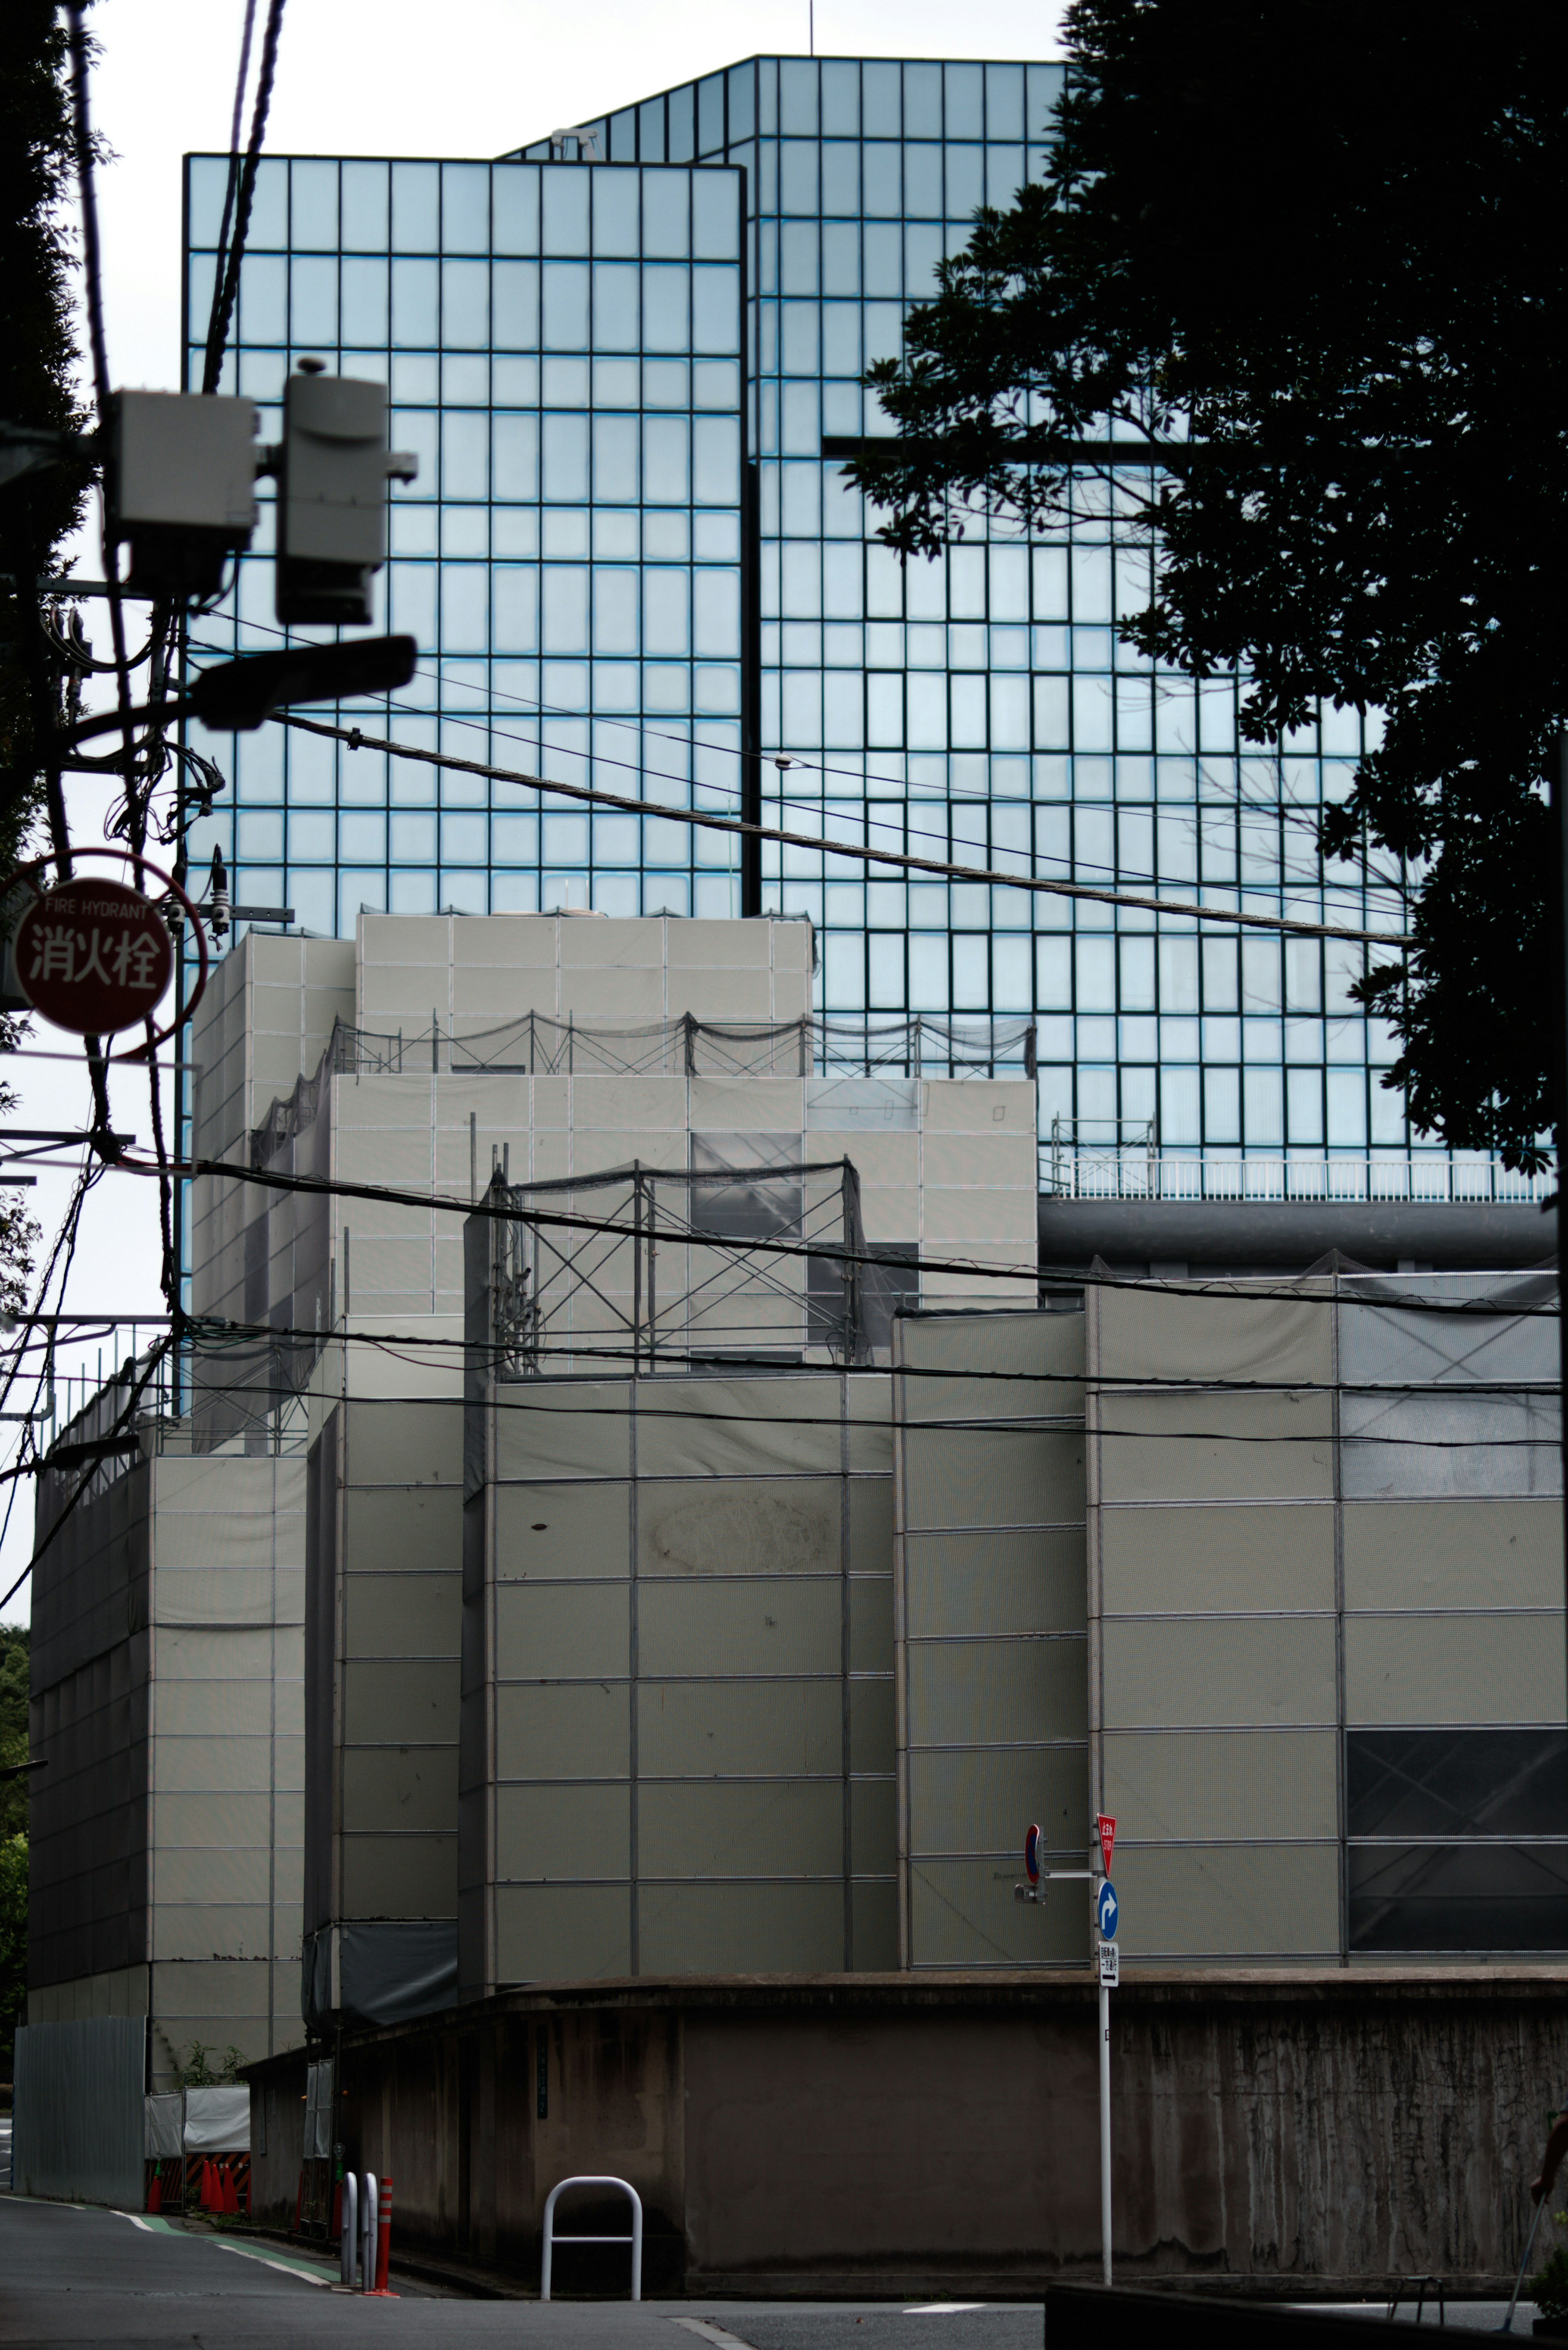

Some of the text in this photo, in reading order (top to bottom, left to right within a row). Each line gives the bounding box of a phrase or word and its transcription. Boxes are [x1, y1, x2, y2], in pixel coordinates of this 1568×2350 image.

[45, 897, 148, 920] FIRE HYDRANT
[30, 923, 160, 989] 消火栓
[1102, 1822, 1113, 1836] 止まれ
[1101, 1947, 1117, 1958] 自転車を除く
[1101, 1960, 1117, 1971] 一方通行
